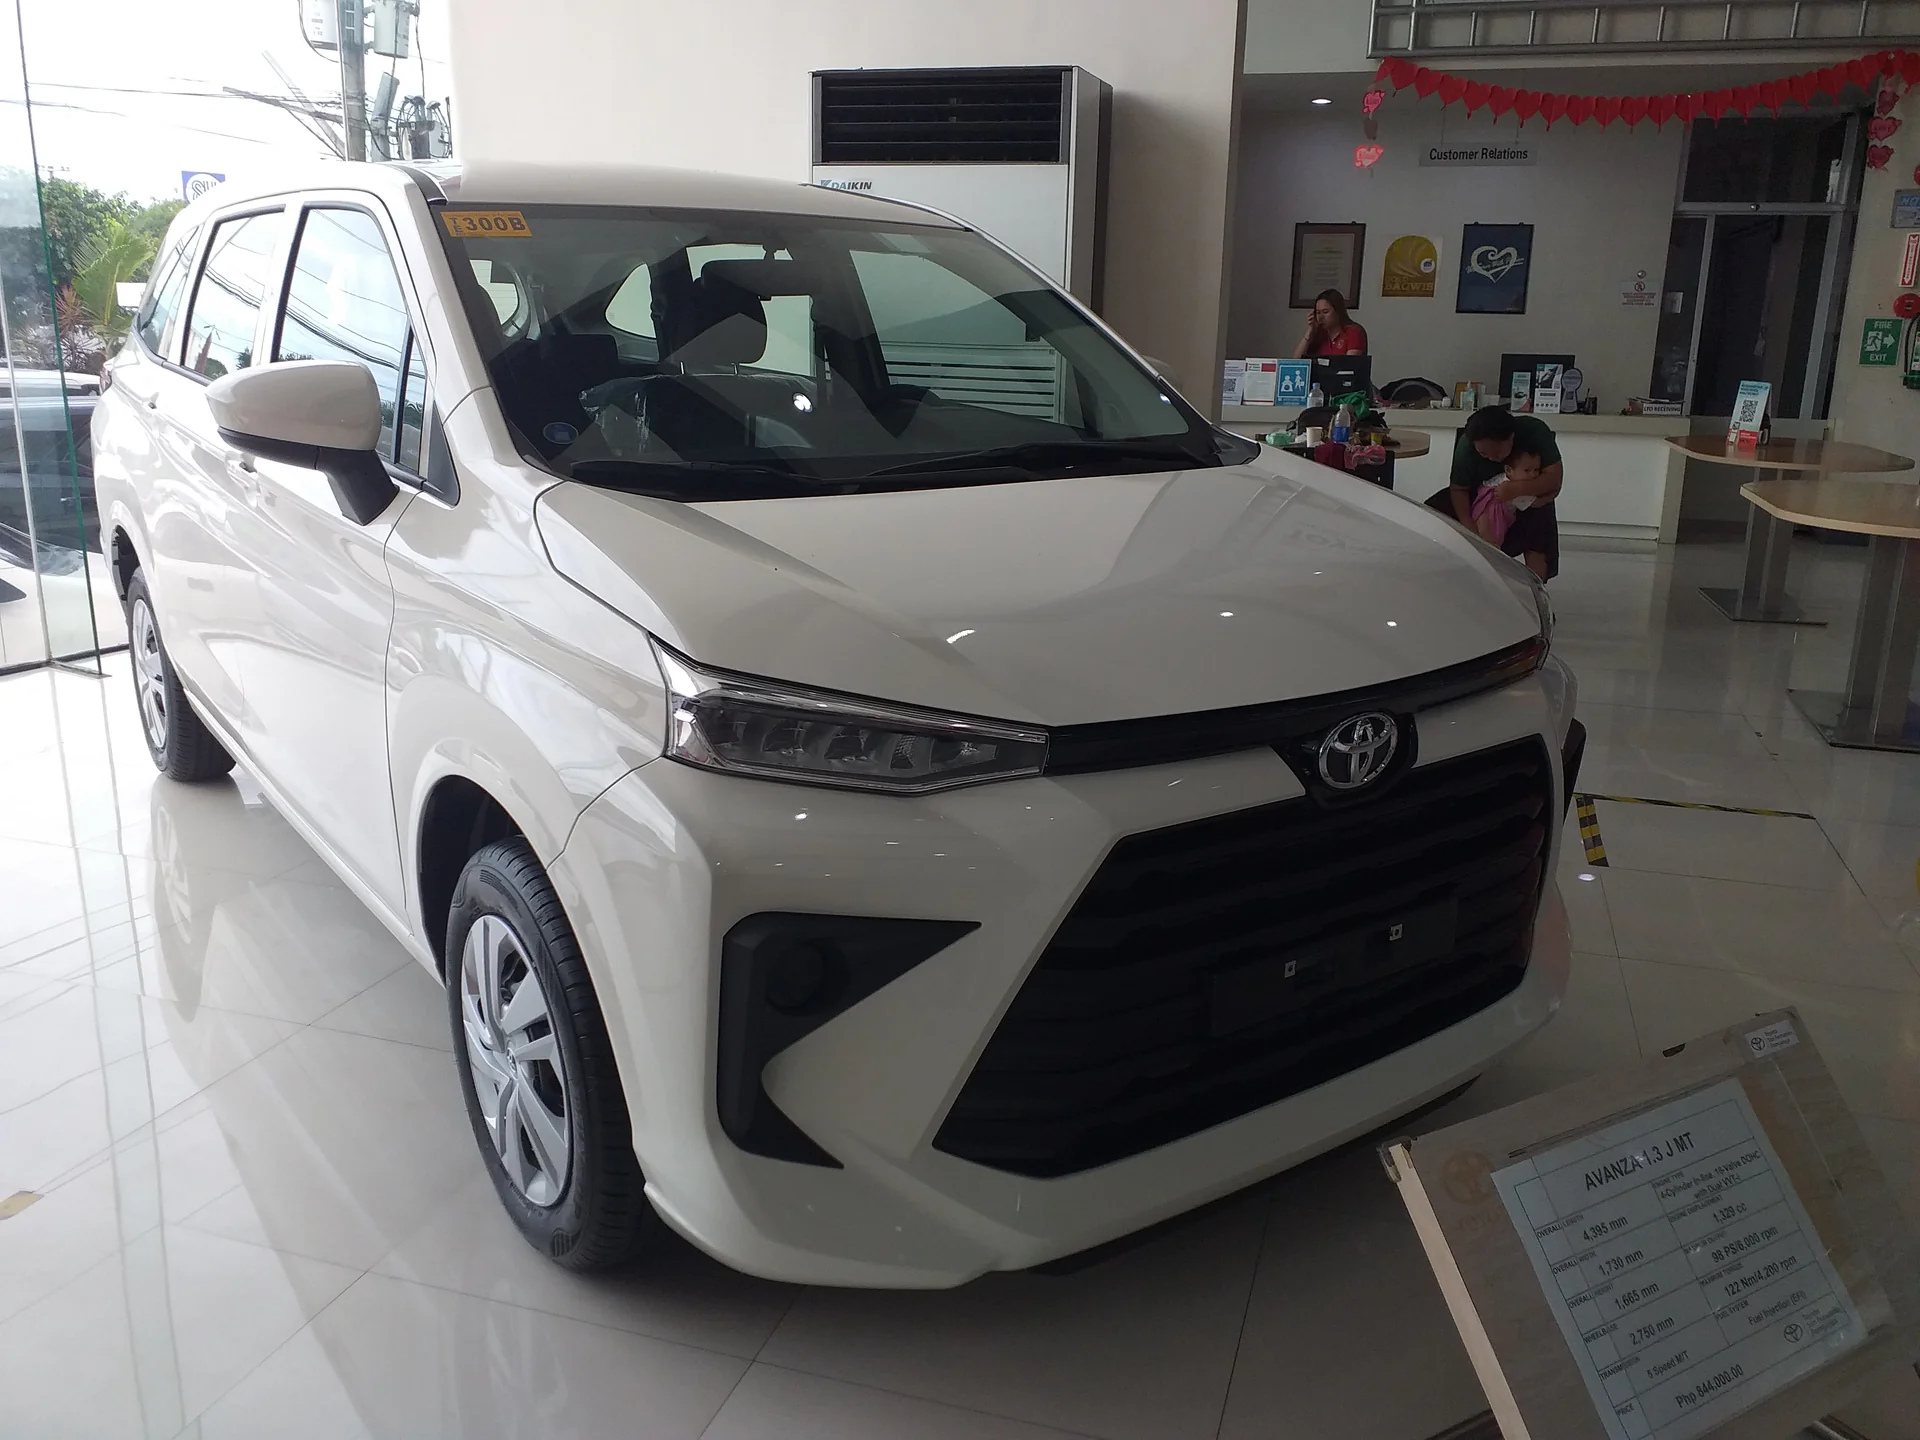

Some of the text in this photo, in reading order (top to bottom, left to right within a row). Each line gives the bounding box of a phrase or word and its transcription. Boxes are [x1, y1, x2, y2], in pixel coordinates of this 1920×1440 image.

[1429, 148, 1528, 160] Customer Relations
[831, 181, 872, 190] DAIKIN
[463, 217, 526, 231] 300B
[1873, 321, 1893, 329] FIRE
[1869, 353, 1887, 361] EXIT
[1584, 1131, 1693, 1191] AVANZA 1.3 J MT
[1740, 1150, 1760, 1164] DOHC
[1712, 1202, 1747, 1223] 1,329 cc
[1536, 1223, 1561, 1238] OVERALL
[1583, 1216, 1628, 1240] 4,395 mm
[1711, 1226, 1778, 1262] 98 PS/6,000 rpm
[1552, 1259, 1578, 1274] OVERALL
[1598, 1250, 1643, 1275] 1,730 mm
[1724, 1255, 1797, 1296] 122 Nm/4,200 rpm
[1567, 1293, 1594, 1310] OVERALL
[1614, 1282, 1659, 1309] 1,665 mm
[1747, 1311, 1763, 1325] Fuel
[1629, 1316, 1674, 1345] 2,750 mm
[1599, 1356, 1640, 1380] TRANSMN
[1652, 1357, 1676, 1375] Speed
[1674, 1349, 1688, 1364] M/T
[1675, 1364, 1744, 1408] Php 844,000.00
[1615, 1402, 1634, 1418] PRICE
